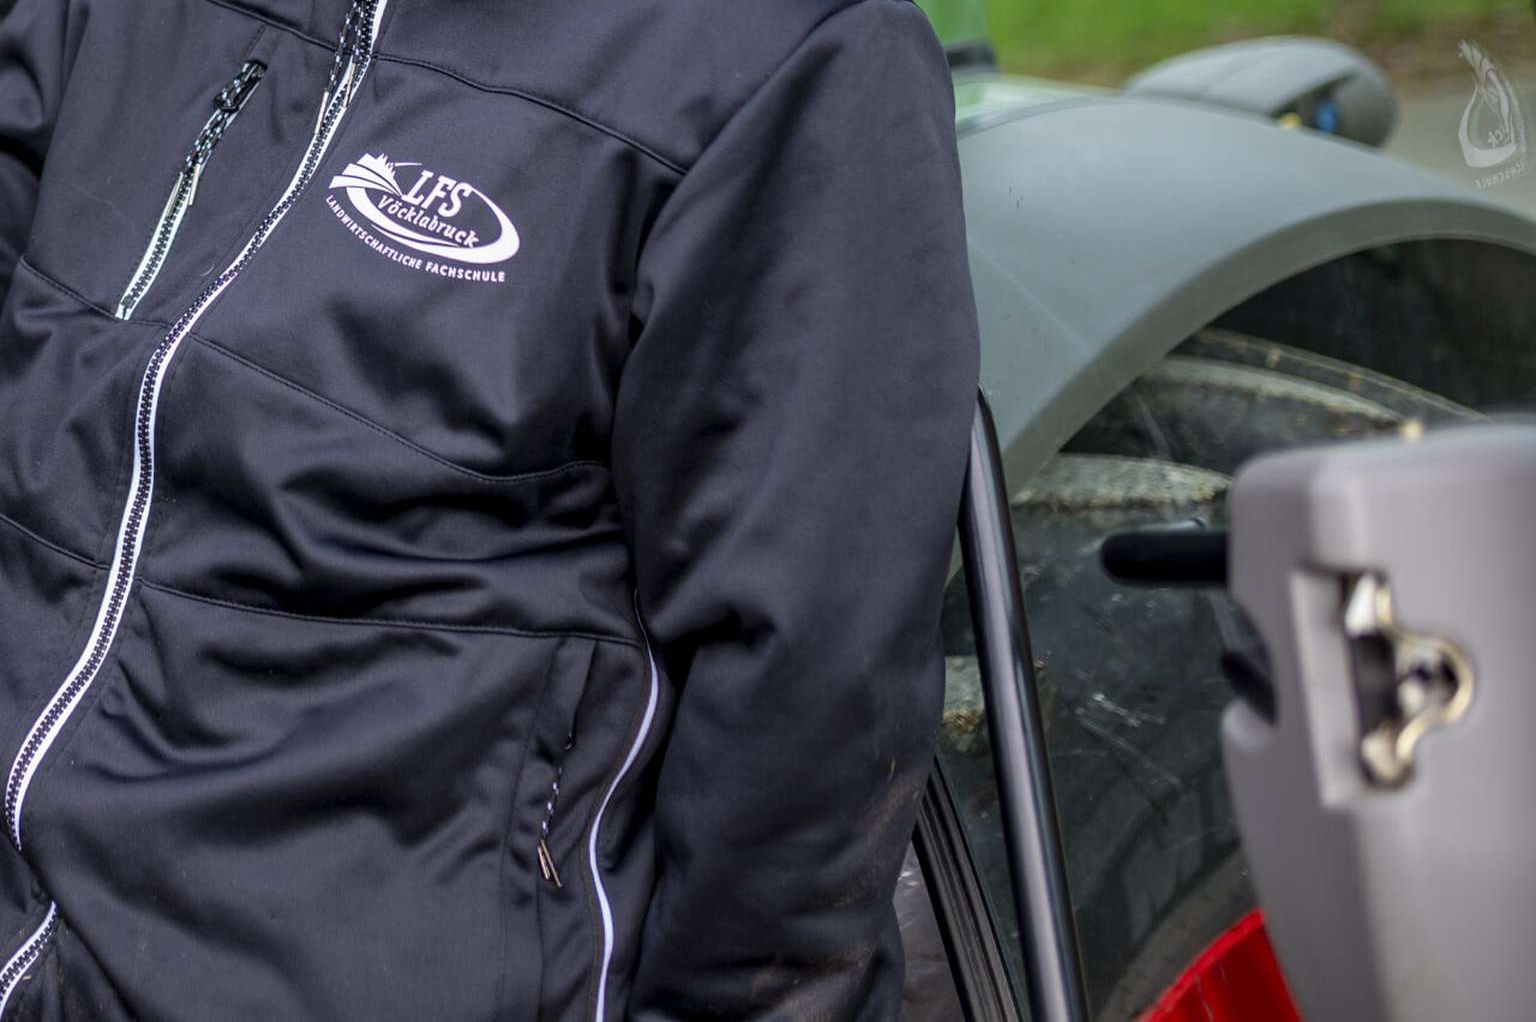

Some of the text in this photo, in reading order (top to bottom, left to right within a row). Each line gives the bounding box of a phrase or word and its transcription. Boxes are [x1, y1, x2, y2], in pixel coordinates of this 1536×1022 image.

[401, 169, 472, 218] LFS
[325, 194, 506, 282] LANDWIRTSCHAFTLICHE FACHSCHULE
[377, 194, 479, 248] Vöcklabruck
